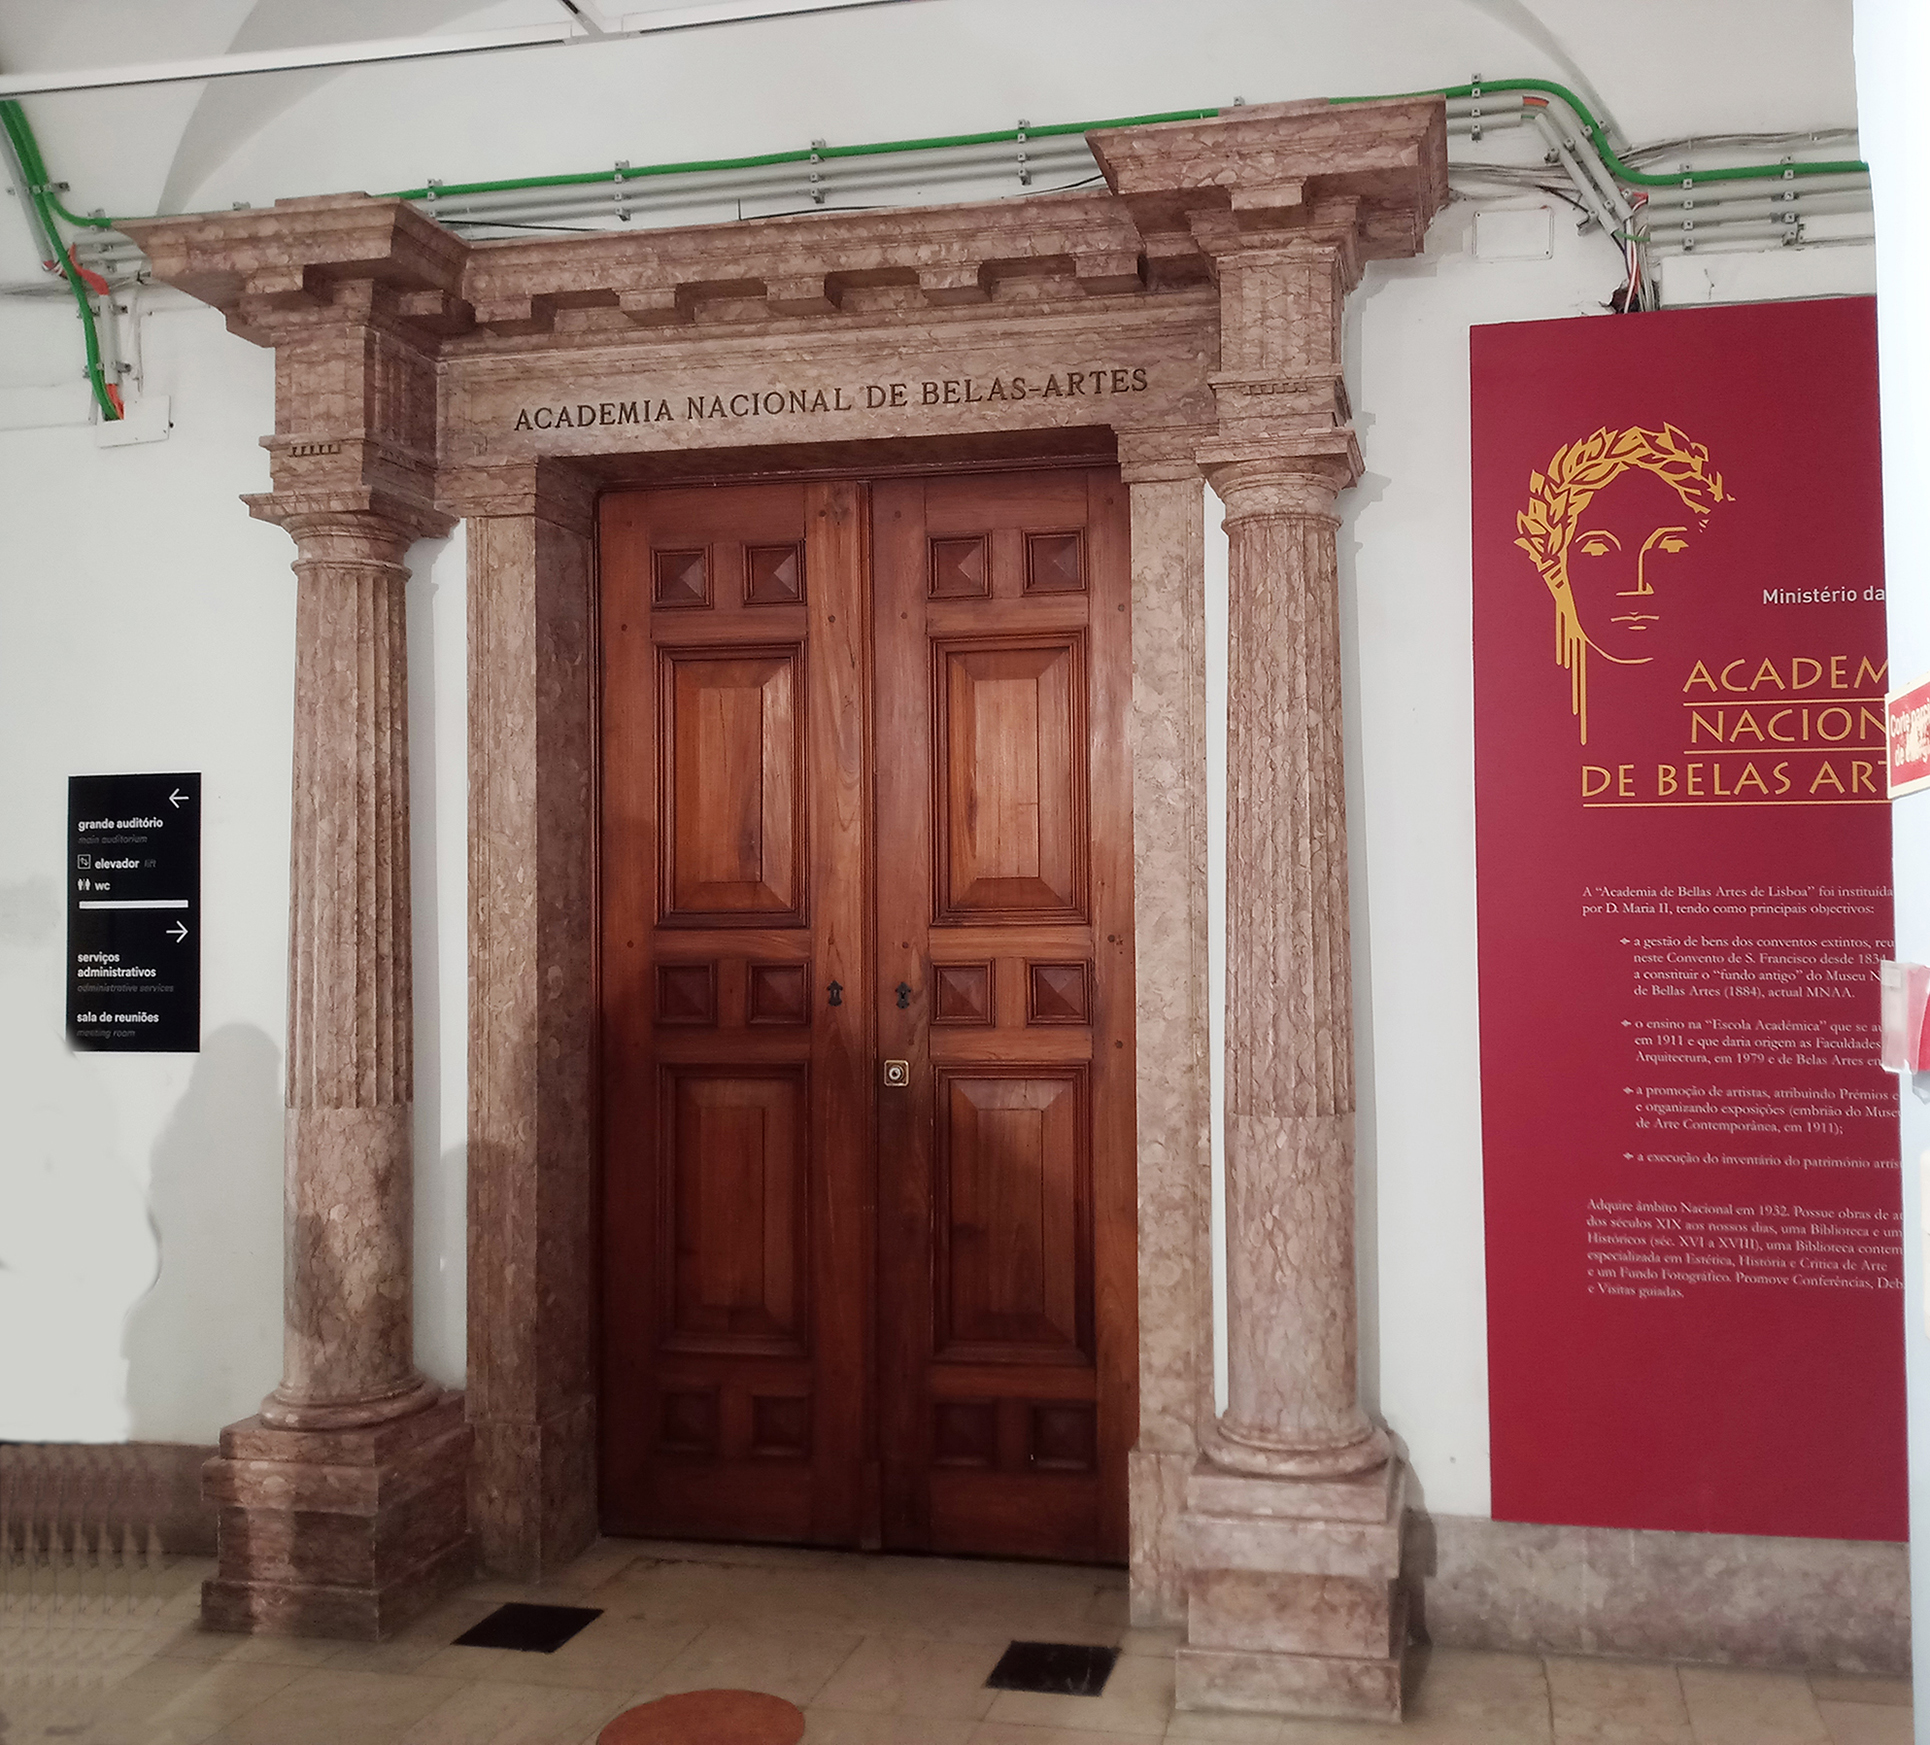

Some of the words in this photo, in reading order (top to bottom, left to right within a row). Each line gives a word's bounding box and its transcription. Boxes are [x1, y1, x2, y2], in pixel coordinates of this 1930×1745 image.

[514, 398, 675, 432] ACADEMIA
[687, 384, 852, 420] NACIONAL
[865, 382, 908, 409] DE
[921, 367, 1150, 403] BELAS-ARTES
[1763, 586, 1857, 605] Ministério
[1863, 586, 1886, 602] da
[1582, 764, 1636, 797] DE
[1657, 762, 1791, 796] BELAS
[1809, 761, 1887, 794] AR
[78, 818, 115, 831] grande
[116, 816, 163, 830] auditório
[94, 858, 140, 869] elevador
[94, 881, 111, 891] wc
[1582, 886, 1592, 897] A
[1660, 886, 1674, 897] de
[1678, 886, 1712, 897] Bellas
[1715, 886, 1748, 897] Artes
[1751, 886, 1765, 897] de
[1818, 885, 1835, 897] foi
[1582, 905, 1603, 917] por
[1605, 902, 1619, 914] D.
[1622, 902, 1656, 914] Maria
[1676, 902, 1710, 914] tendo
[1712, 905, 1747, 914] como
[1750, 903, 1807, 917] principais
[1810, 903, 1875, 917] objectivos:
[1633, 938, 1641, 947] a
[1643, 935, 1681, 950] gestão
[1683, 935, 1698, 947] de
[1701, 935, 1729, 947] bens
[1731, 935, 1754, 947] dos
[1756, 937, 1818, 948] conventos
[1820, 936, 1872, 949] extintos,
[77, 951, 120, 966] serviços
[1633, 953, 1664, 963] neste
[1666, 952, 1725, 964] Convento
[1727, 952, 1743, 964] de
[1744, 952, 1756, 964] S.
[1759, 952, 1817, 965] Francisco
[1820, 953, 1855, 965] desde
[77, 966, 157, 978] administrativos
[1633, 971, 1641, 980] a
[1643, 968, 1699, 980] constituir
[1701, 972, 1710, 980] o
[1806, 969, 1823, 981] do
[1826, 970, 1866, 982] Museu
[1633, 985, 1648, 996] de
[1651, 985, 1686, 997] Bellas
[1689, 985, 1721, 997] Artes
[1768, 986, 1803, 998] actual
[76, 1012, 98, 1023] sala
[99, 1012, 113, 1023] de
[114, 1011, 159, 1023] reuniões
[1634, 1020, 1644, 1028] o
[1646, 1018, 1685, 1030] ensino
[1688, 1021, 1702, 1030] na
[1829, 1023, 1852, 1035] que
[1855, 1024, 1868, 1032] se
[1634, 1037, 1653, 1046] em
[1656, 1035, 1683, 1046] 1911
[1687, 1038, 1695, 1046] e
[1697, 1038, 1720, 1050] que
[1722, 1035, 1751, 1047] daria
[1754, 1035, 1796, 1051] origem
[1799, 1039, 1813, 1049] as
[1816, 1037, 1882, 1049] Faculdades
[1636, 1050, 1712, 1066] Arquitectura,
[1714, 1055, 1733, 1064] em
[1737, 1053, 1765, 1064] 1979
[1768, 1056, 1775, 1064] e
[1777, 1054, 1793, 1065] de
[1796, 1054, 1828, 1065] Belas
[1831, 1054, 1864, 1066] Artes
[1636, 1087, 1643, 1095] a
[1645, 1085, 1706, 1098] promoção
[1708, 1085, 1723, 1097] de
[1773, 1086, 1836, 1100] atribuindo
[1839, 1089, 1889, 1101] Prémios
[1635, 1104, 1643, 1112] e
[1645, 1101, 1718, 1115] organizando
[1721, 1102, 1785, 1118] exposições
[1845, 1105, 1862, 1117] do
[1635, 1117, 1651, 1129] de
[1654, 1117, 1681, 1130] Arte
[1783, 1123, 1803, 1132] em
[1637, 1153, 1644, 1162] a
[1702, 1152, 1719, 1164] do
[1722, 1152, 1782, 1166] inventário
[1784, 1155, 1801, 1167] do
[1587, 1198, 1634, 1215] Adquire
[1680, 1201, 1734, 1215] Nacional
[1736, 1207, 1755, 1216] em
[1838, 1207, 1872, 1220] obras
[1874, 1208, 1890, 1220] de
[1586, 1215, 1608, 1227] dos
[1656, 1217, 1682, 1230] XIX
[1685, 1222, 1705, 1231] aos
[1708, 1223, 1748, 1233] nossos
[1781, 1226, 1807, 1235] uma
[1766, 1241, 1792, 1251] uma
[1587, 1250, 1662, 1264] especializada
[1663, 1254, 1683, 1263] em
[1842, 1259, 1858, 1271] de
[1861, 1259, 1888, 1272] Arte
[1597, 1269, 1617, 1278] um
[1619, 1266, 1659, 1279] Fundo
